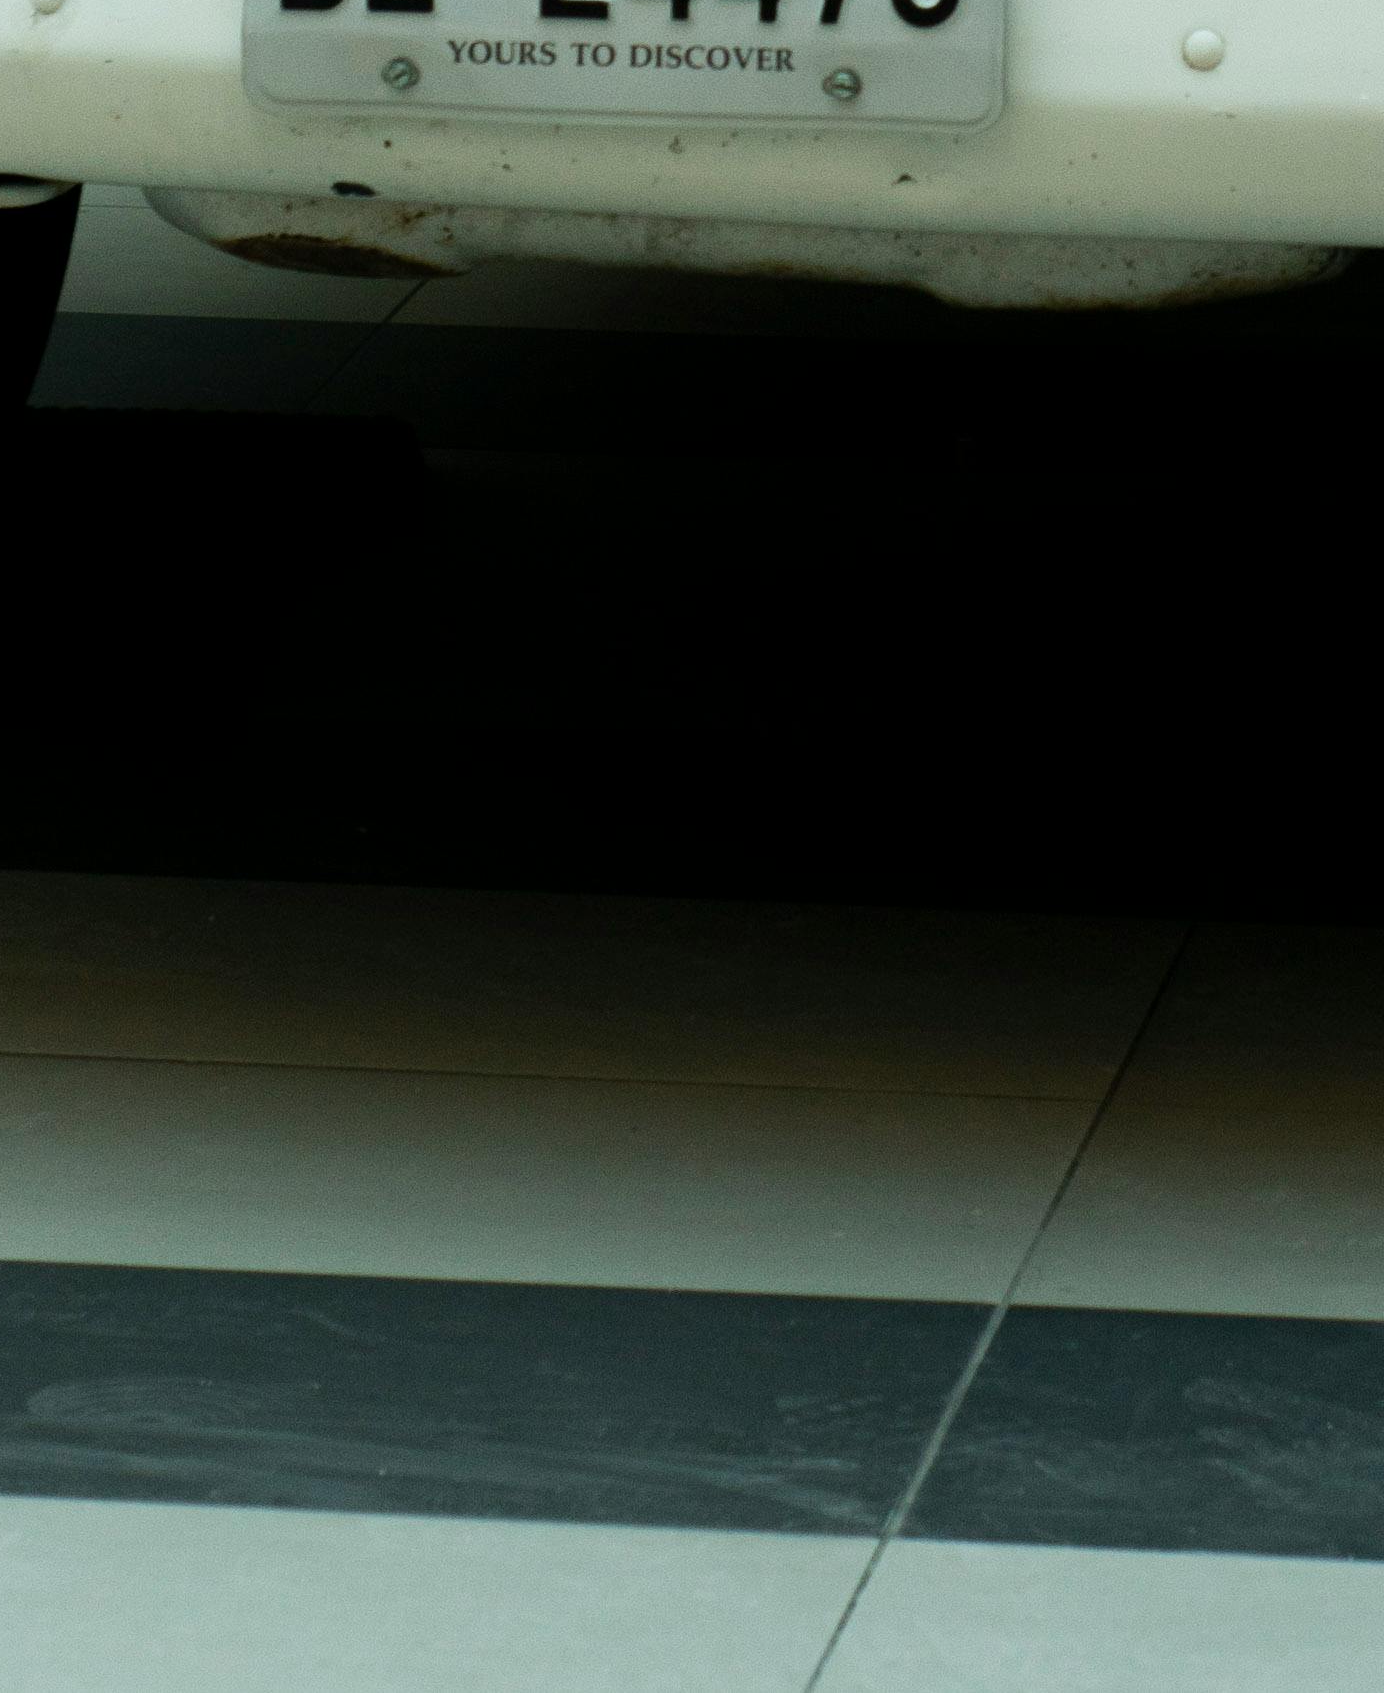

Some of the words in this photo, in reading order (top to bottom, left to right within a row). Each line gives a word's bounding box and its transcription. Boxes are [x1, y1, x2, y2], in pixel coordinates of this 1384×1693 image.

[447, 40, 557, 70] YOURS
[569, 42, 616, 70] TO
[629, 43, 796, 74] DISCOVER
